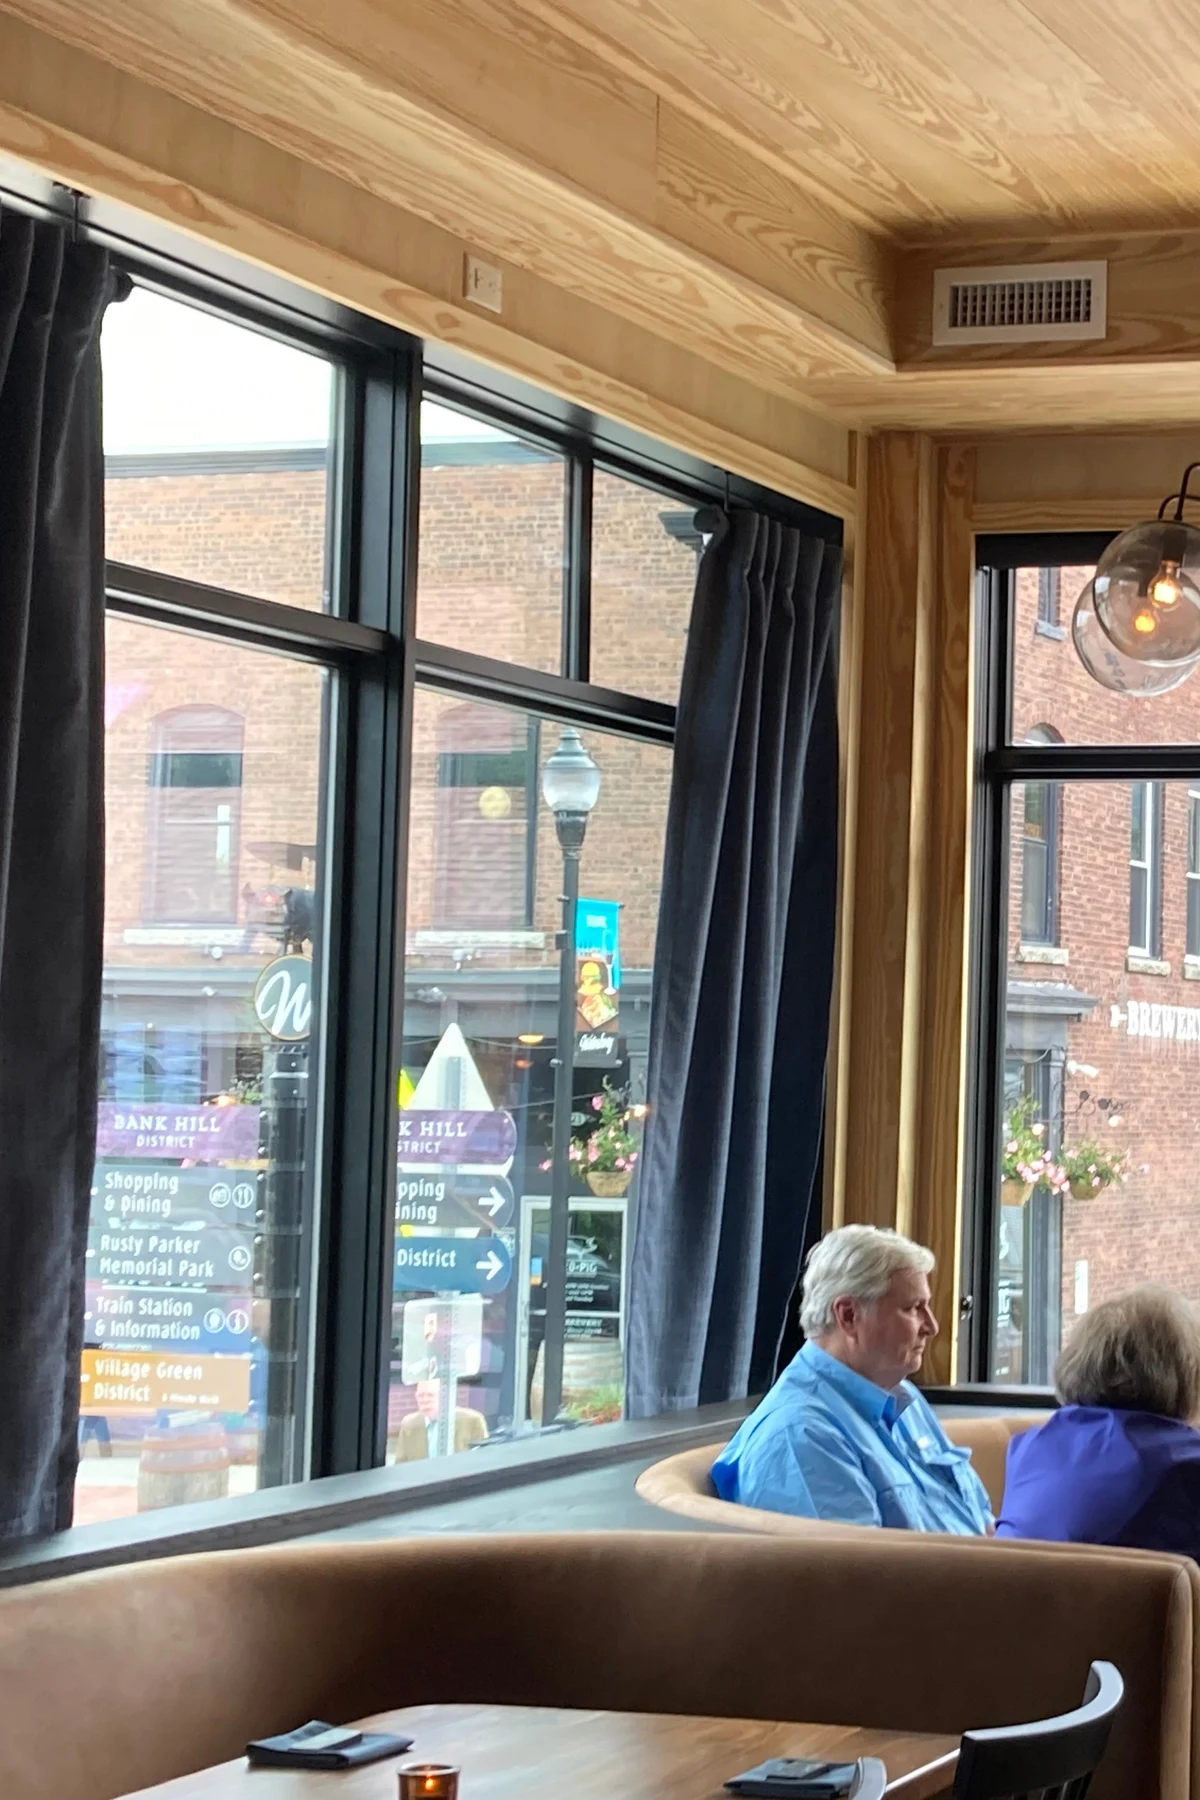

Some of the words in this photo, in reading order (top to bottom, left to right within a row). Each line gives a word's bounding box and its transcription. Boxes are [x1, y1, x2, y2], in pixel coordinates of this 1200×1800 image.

[114, 1114, 168, 1132] BANK
[174, 1116, 221, 1133] HILL
[419, 1121, 467, 1137] HILL
[136, 1135, 196, 1149] DISTRICT
[397, 1140, 441, 1154] STRICT
[104, 1171, 180, 1195] Shopping
[398, 1178, 446, 1202] pping
[104, 1194, 115, 1212] &
[120, 1194, 172, 1218] Dining
[395, 1201, 438, 1224] ining
[101, 1234, 144, 1257] Rusty
[148, 1235, 201, 1254] Parker
[100, 1257, 173, 1276] Memorial
[178, 1259, 214, 1278] Park
[397, 1248, 457, 1268] District
[95, 1296, 133, 1315] Train
[138, 1297, 193, 1317] Station
[95, 1319, 105, 1337] &
[111, 1320, 201, 1341] Information
[95, 1359, 151, 1381] Village
[156, 1361, 203, 1381] Green
[94, 1382, 151, 1402] District
